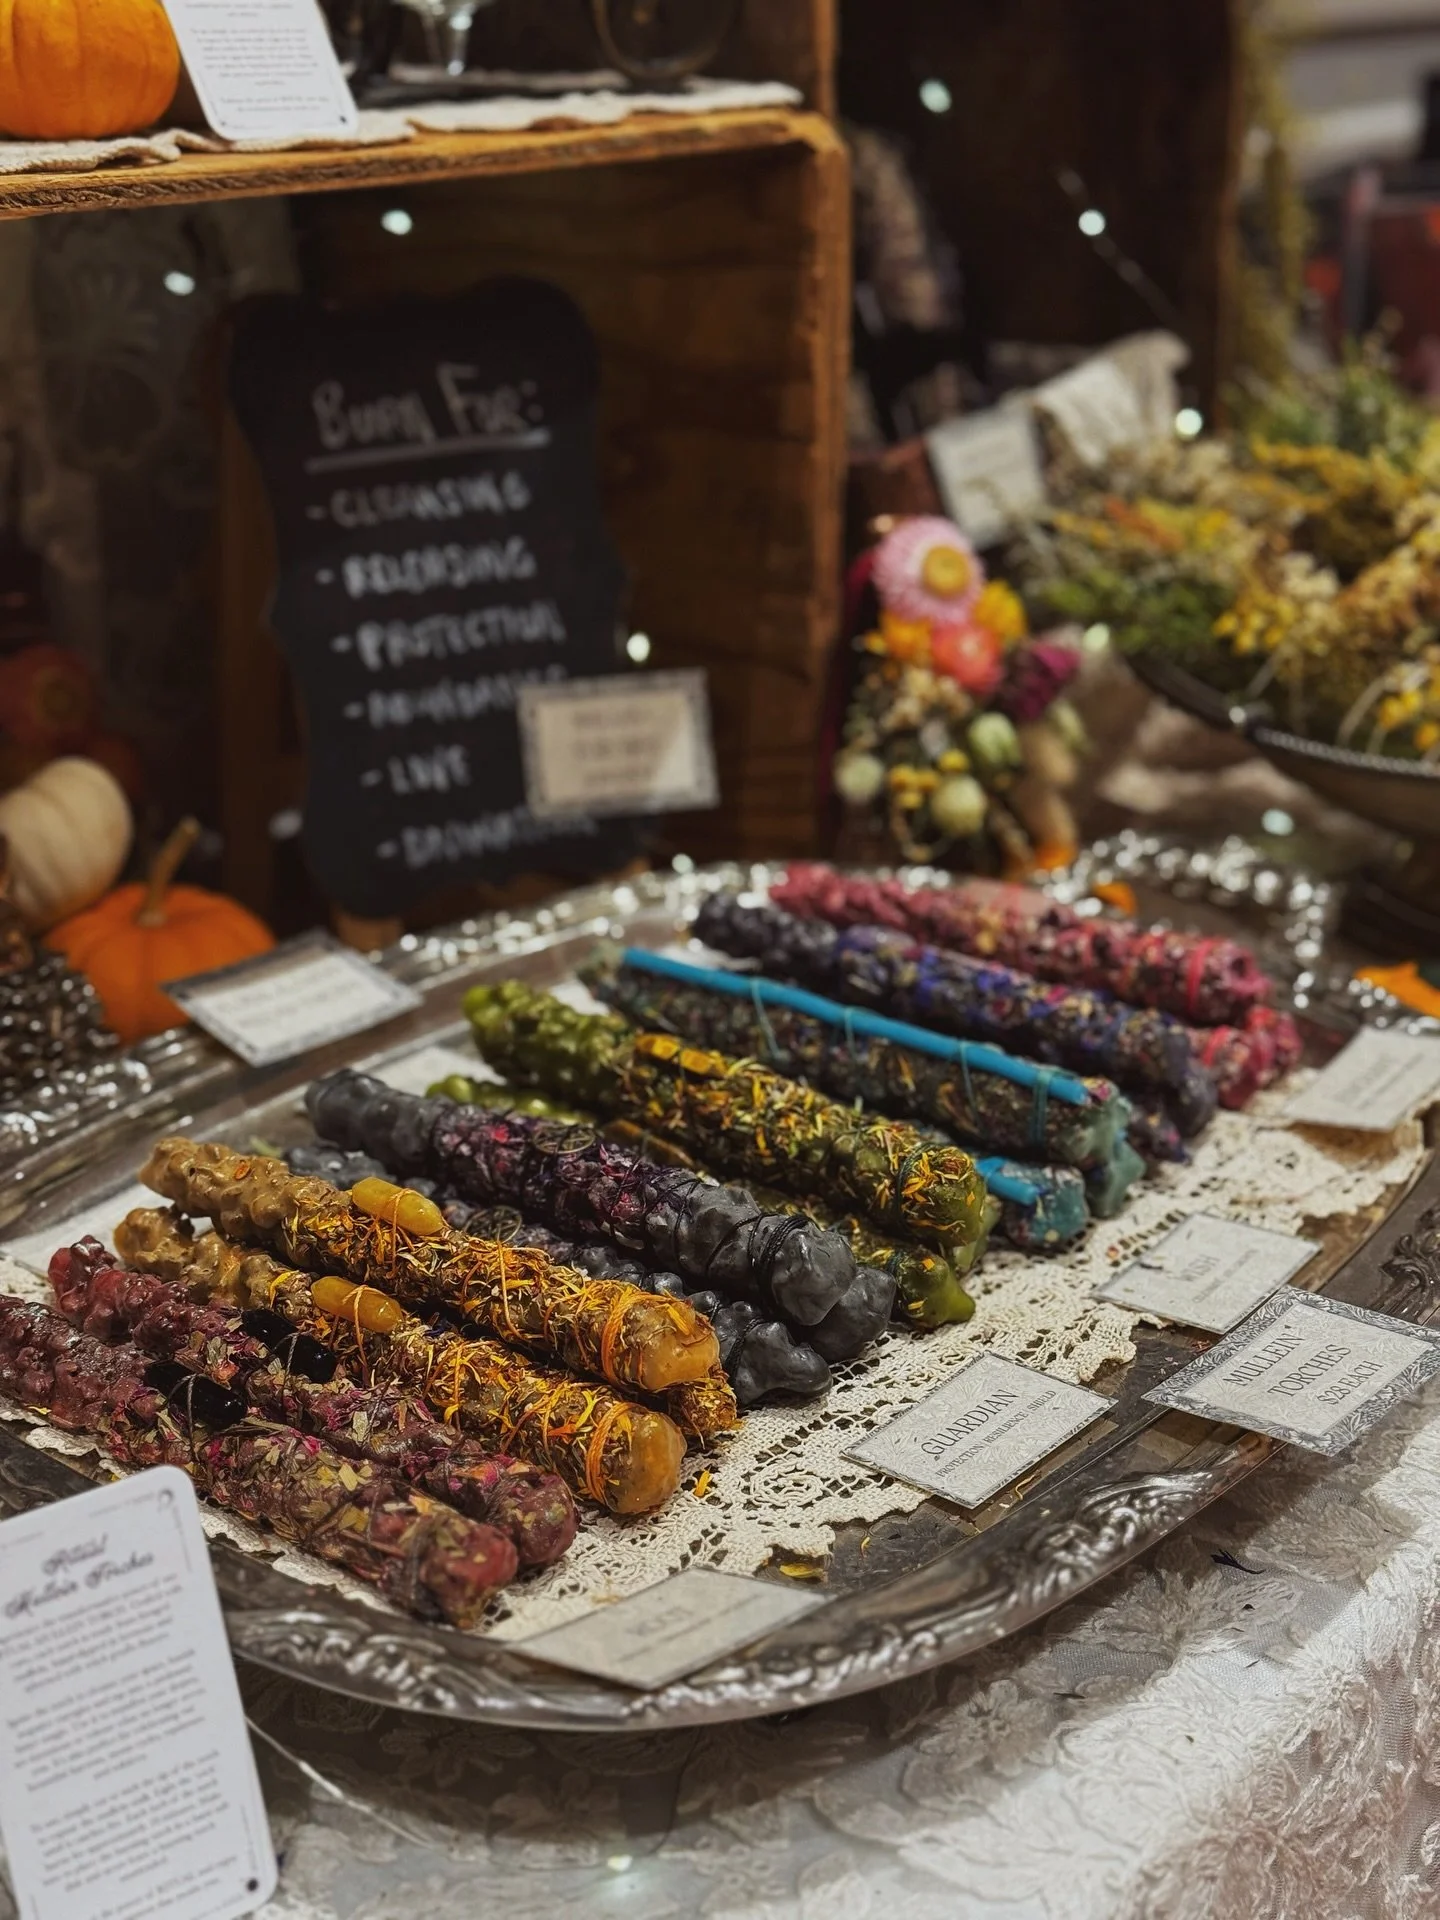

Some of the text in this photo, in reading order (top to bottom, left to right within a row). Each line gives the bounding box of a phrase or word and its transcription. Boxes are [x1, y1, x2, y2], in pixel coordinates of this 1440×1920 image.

[1223, 1332, 1305, 1387] MULLEIN
[1267, 1343, 1351, 1397] TORCHES
[1343, 1360, 1384, 1393] EACH
[921, 1389, 1019, 1457] GUARDIAN
[935, 1440, 986, 1478] PROTECTION
